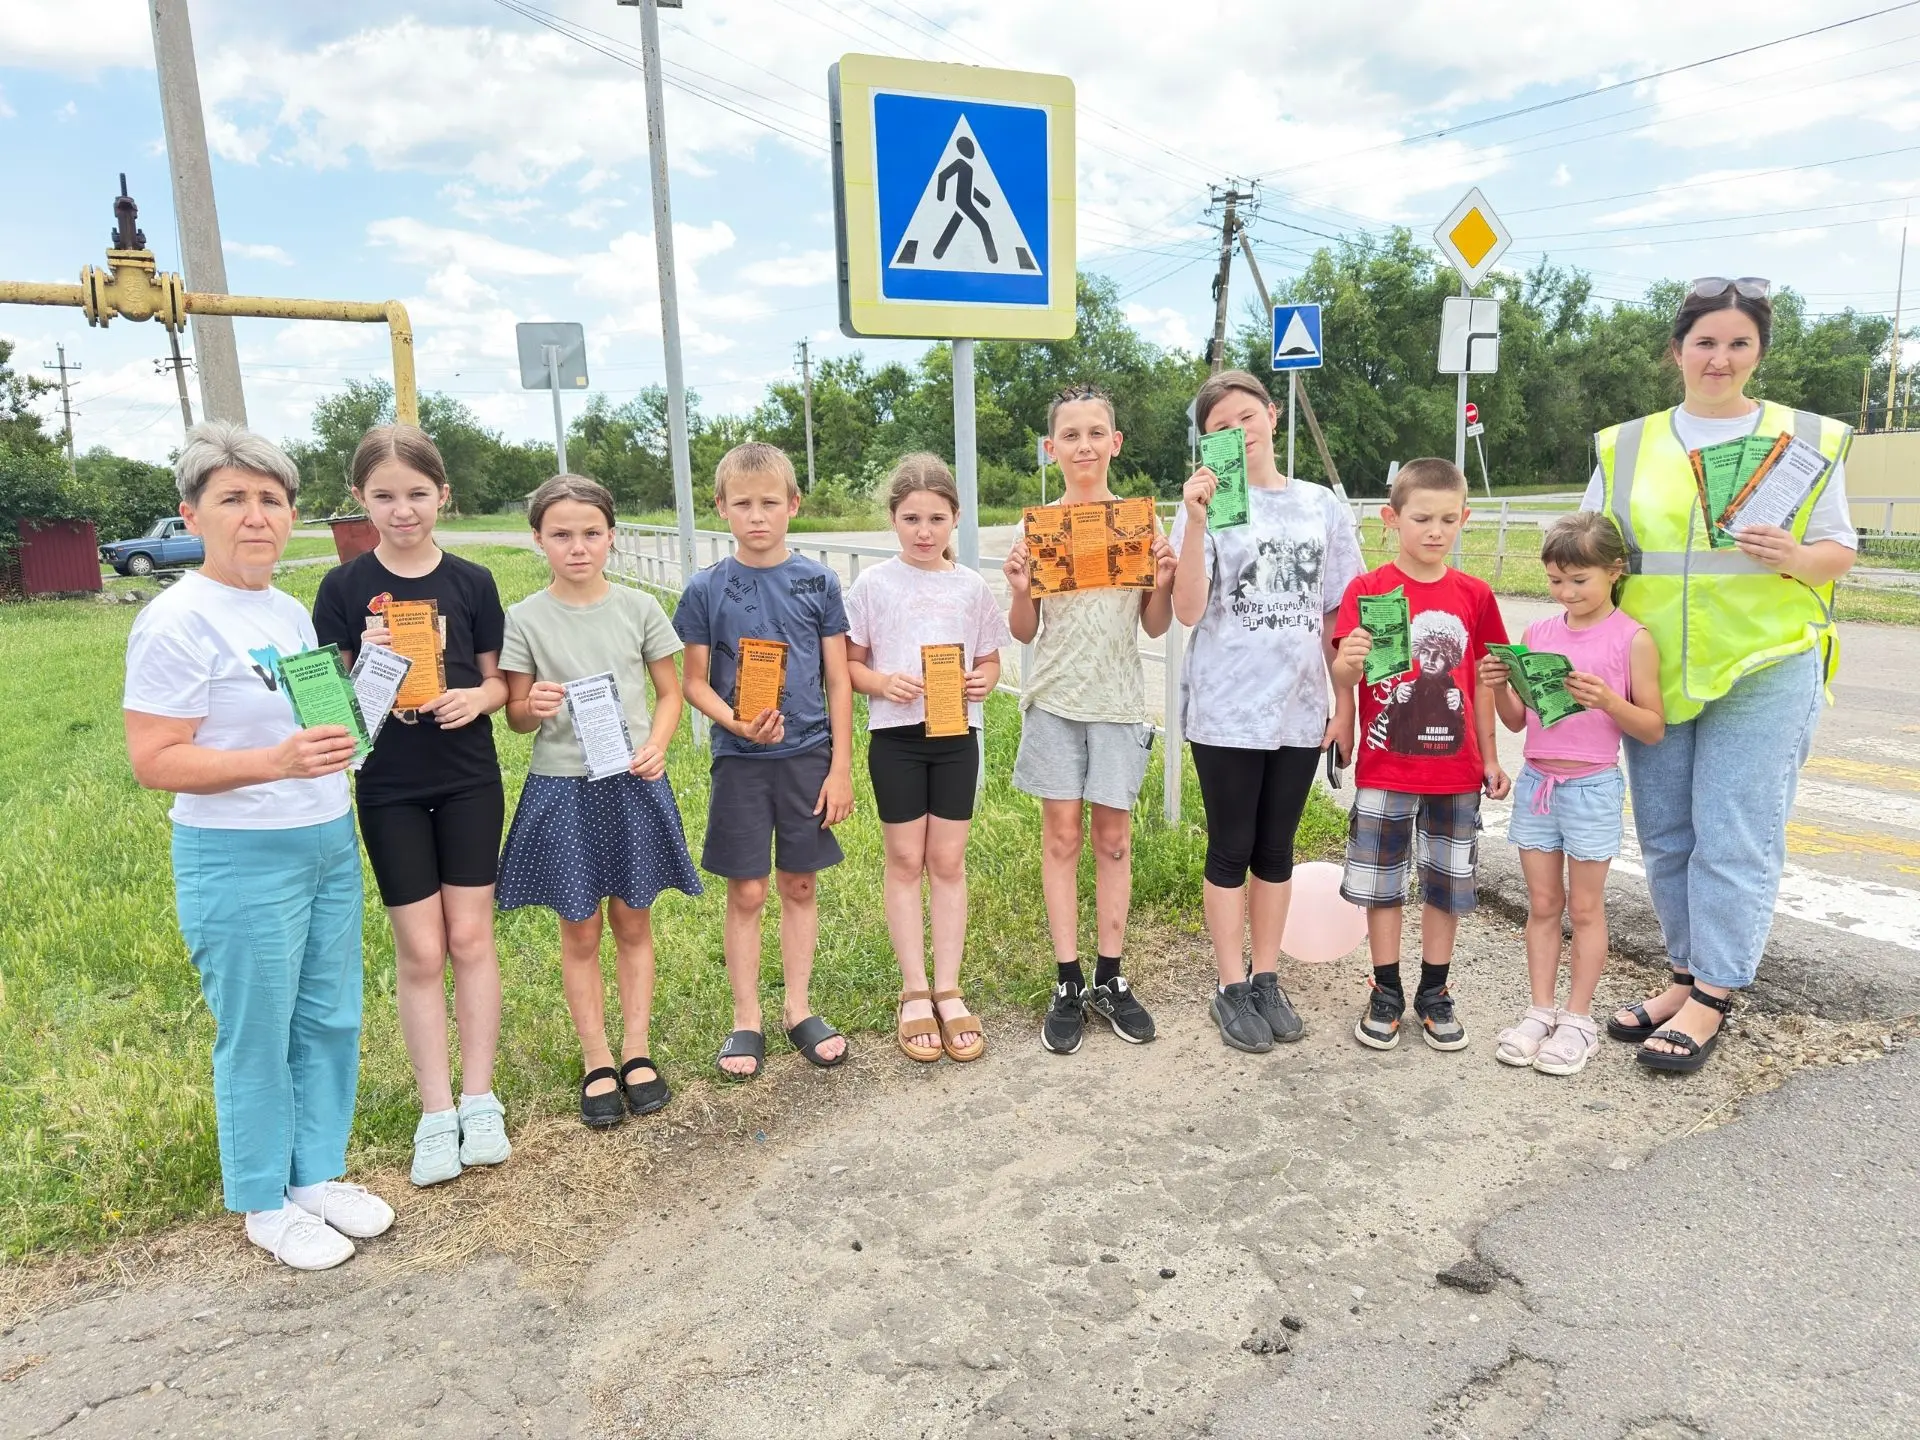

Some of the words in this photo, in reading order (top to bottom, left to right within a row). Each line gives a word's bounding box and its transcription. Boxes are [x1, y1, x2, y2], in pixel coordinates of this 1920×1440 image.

[728, 575, 753, 595] you'll
[724, 587, 743, 603] make
[745, 604, 757, 614] it
[1232, 601, 1263, 617] YOU'RE
[1267, 601, 1303, 612] LITERALLY
[1243, 616, 1263, 631] and
[1366, 712, 1390, 752] The
